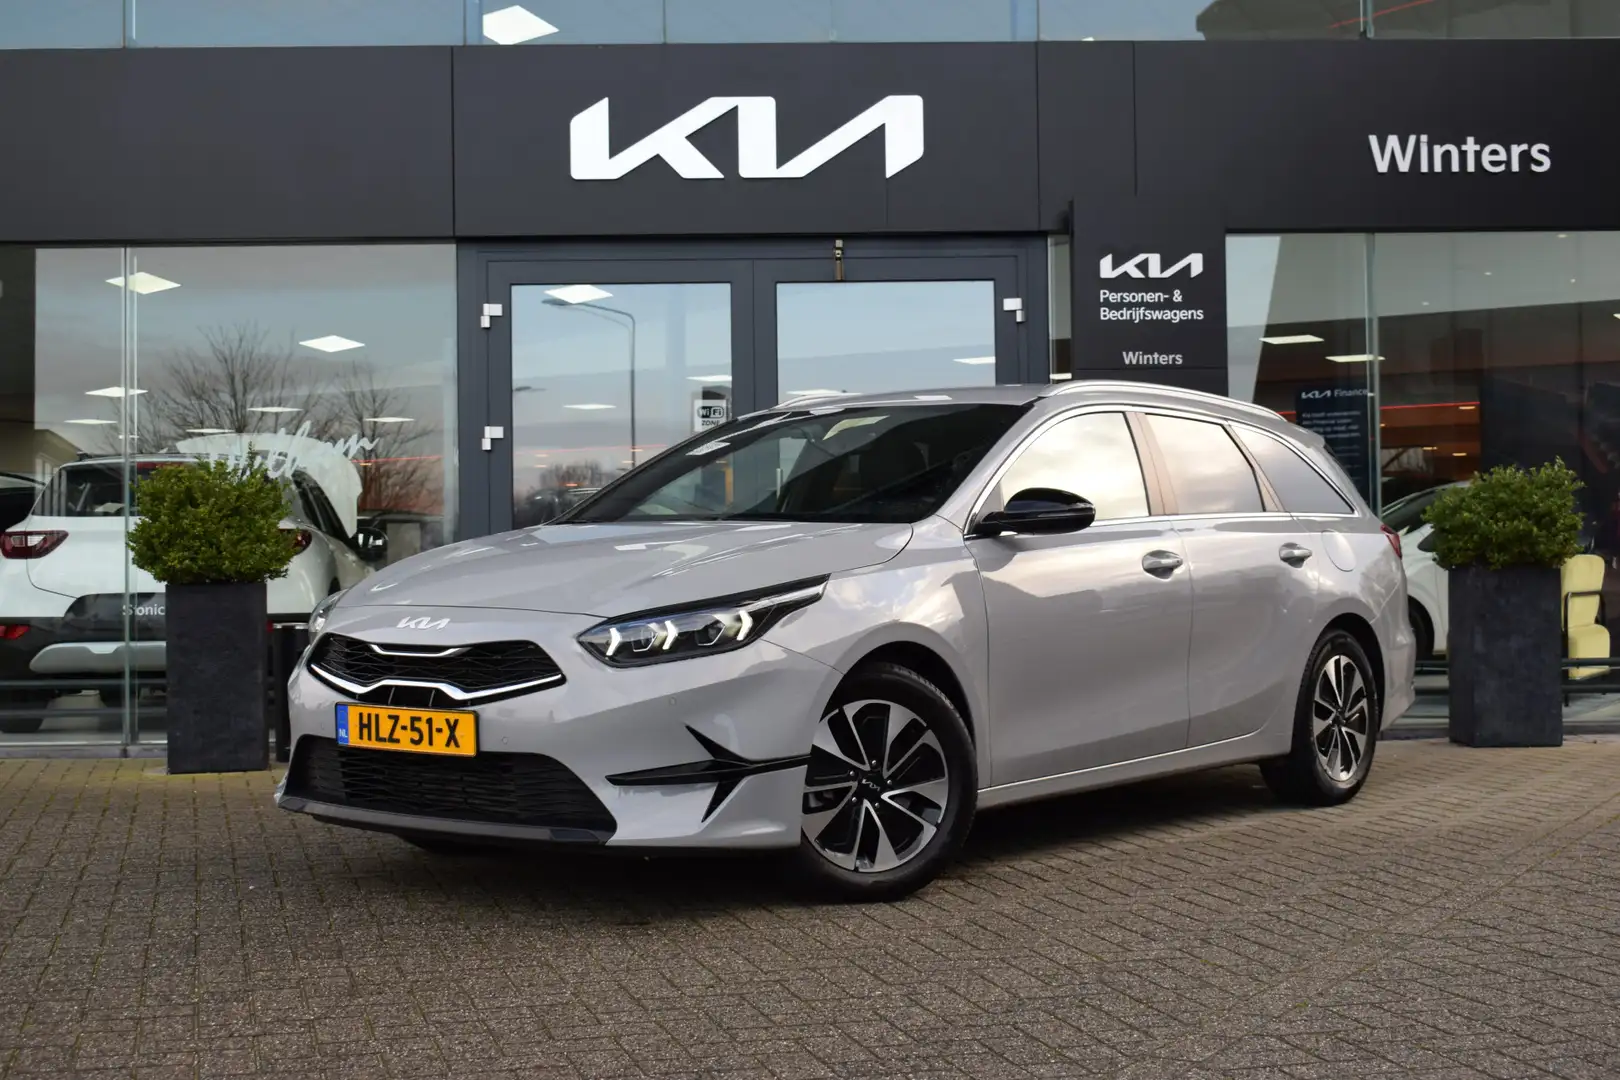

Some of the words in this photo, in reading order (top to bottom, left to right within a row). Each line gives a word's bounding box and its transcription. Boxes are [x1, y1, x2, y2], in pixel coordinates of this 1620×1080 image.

[570, 95, 924, 180] KIA
[1368, 134, 1551, 173] Winters
[1100, 253, 1203, 278] KIA
[1100, 289, 1169, 302] Personen-
[1172, 289, 1183, 302] &
[1100, 307, 1204, 323] Bedrijfswagens
[1122, 351, 1183, 365] Winters
[1301, 389, 1332, 399] KIA
[396, 616, 451, 629] KIA
[339, 729, 348, 738] NL
[358, 712, 460, 748] HLZ-51-X
